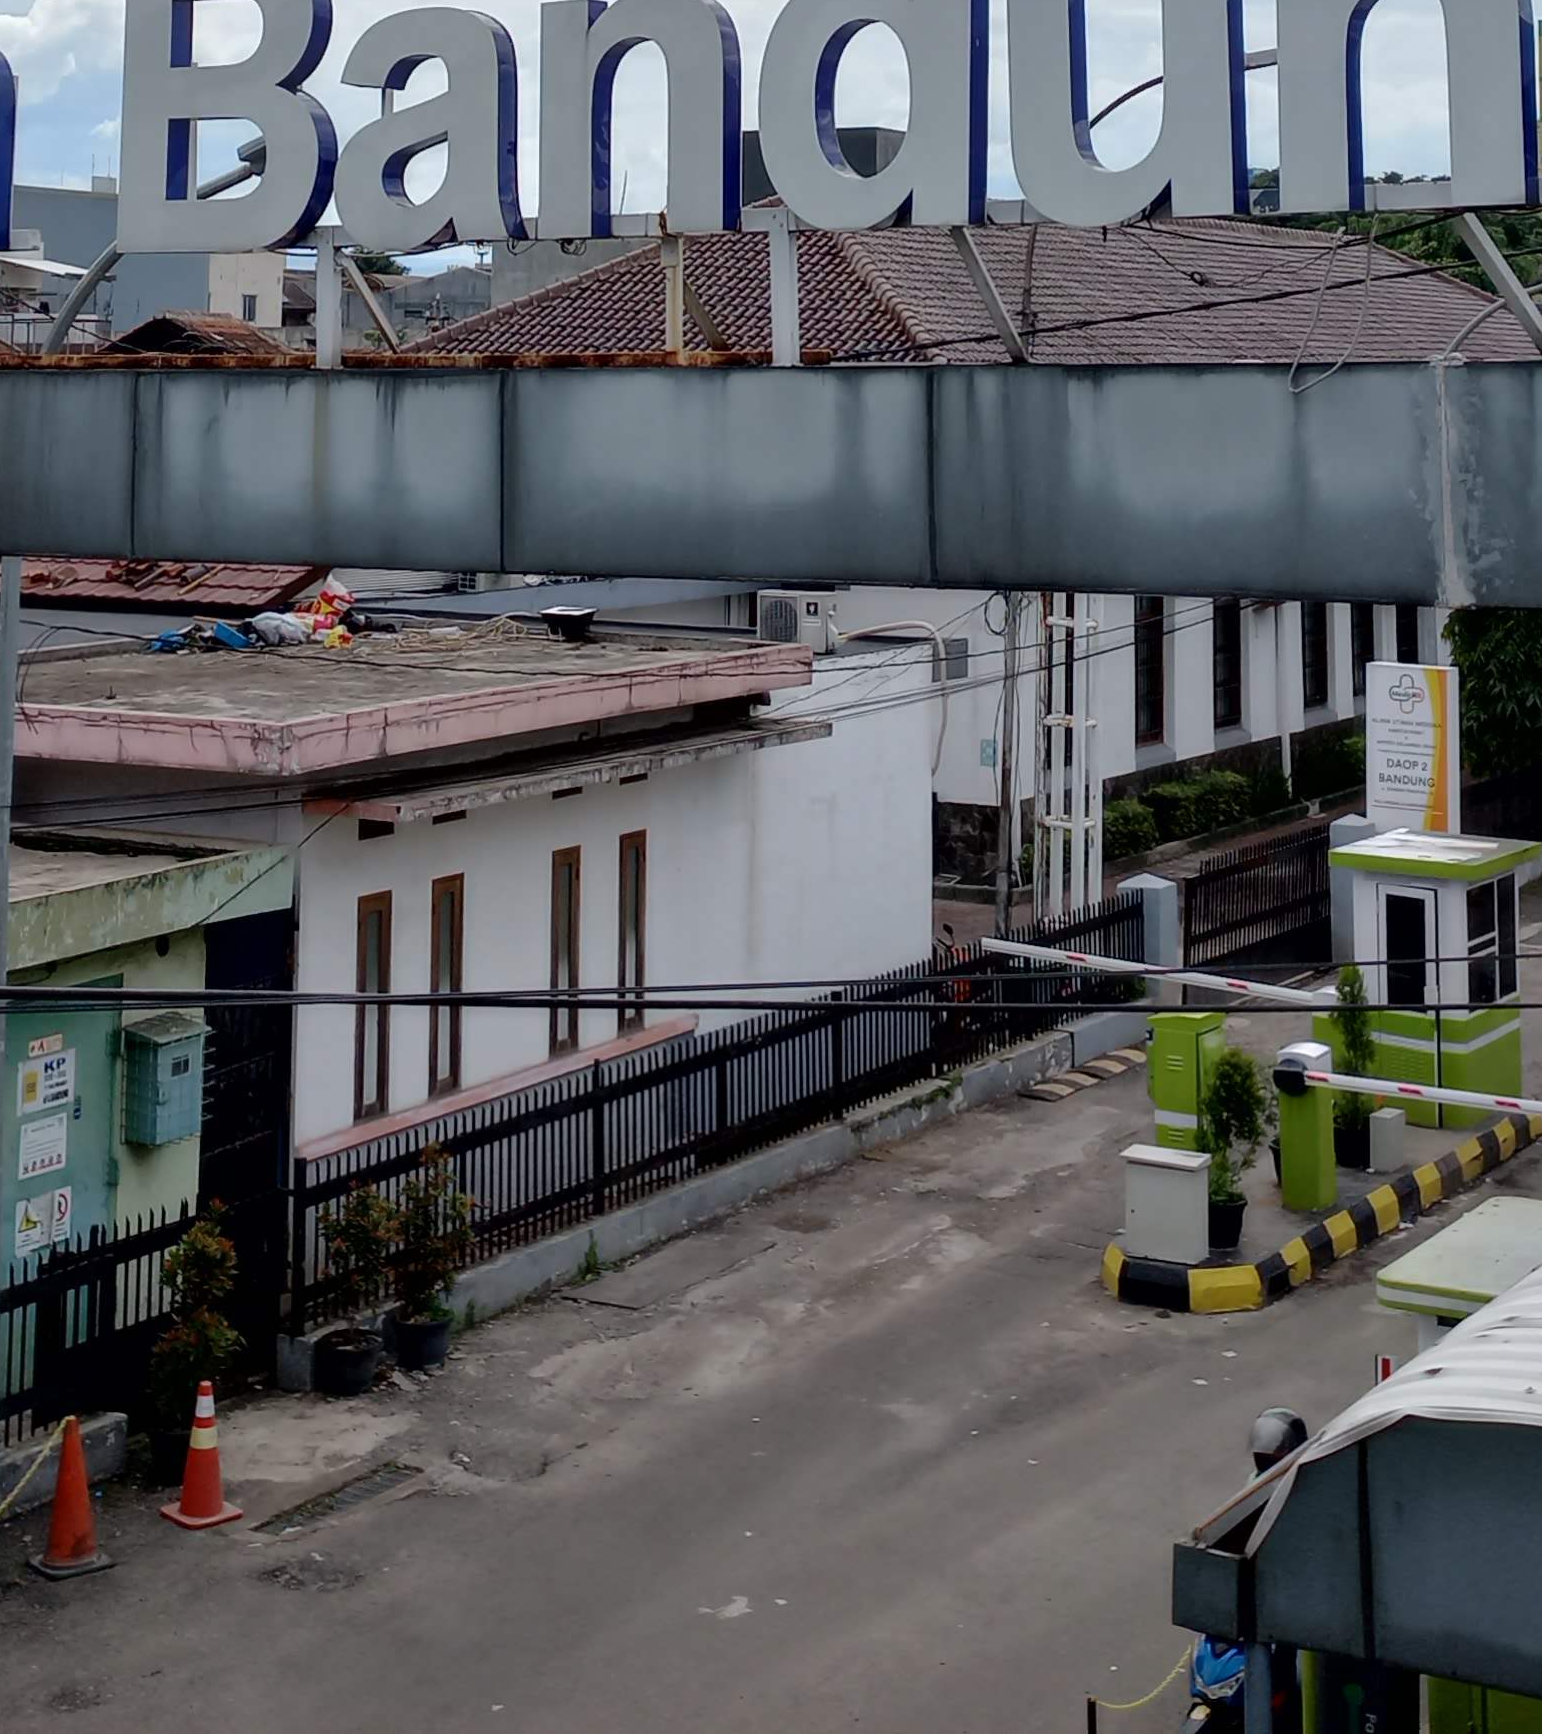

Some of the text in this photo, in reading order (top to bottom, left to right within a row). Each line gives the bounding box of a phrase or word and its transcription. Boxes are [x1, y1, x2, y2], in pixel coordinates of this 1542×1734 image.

[1386, 757, 1428, 772] DAOP 2
[1378, 772, 1436, 788] BANDUNG
[43, 1057, 67, 1074] KP
